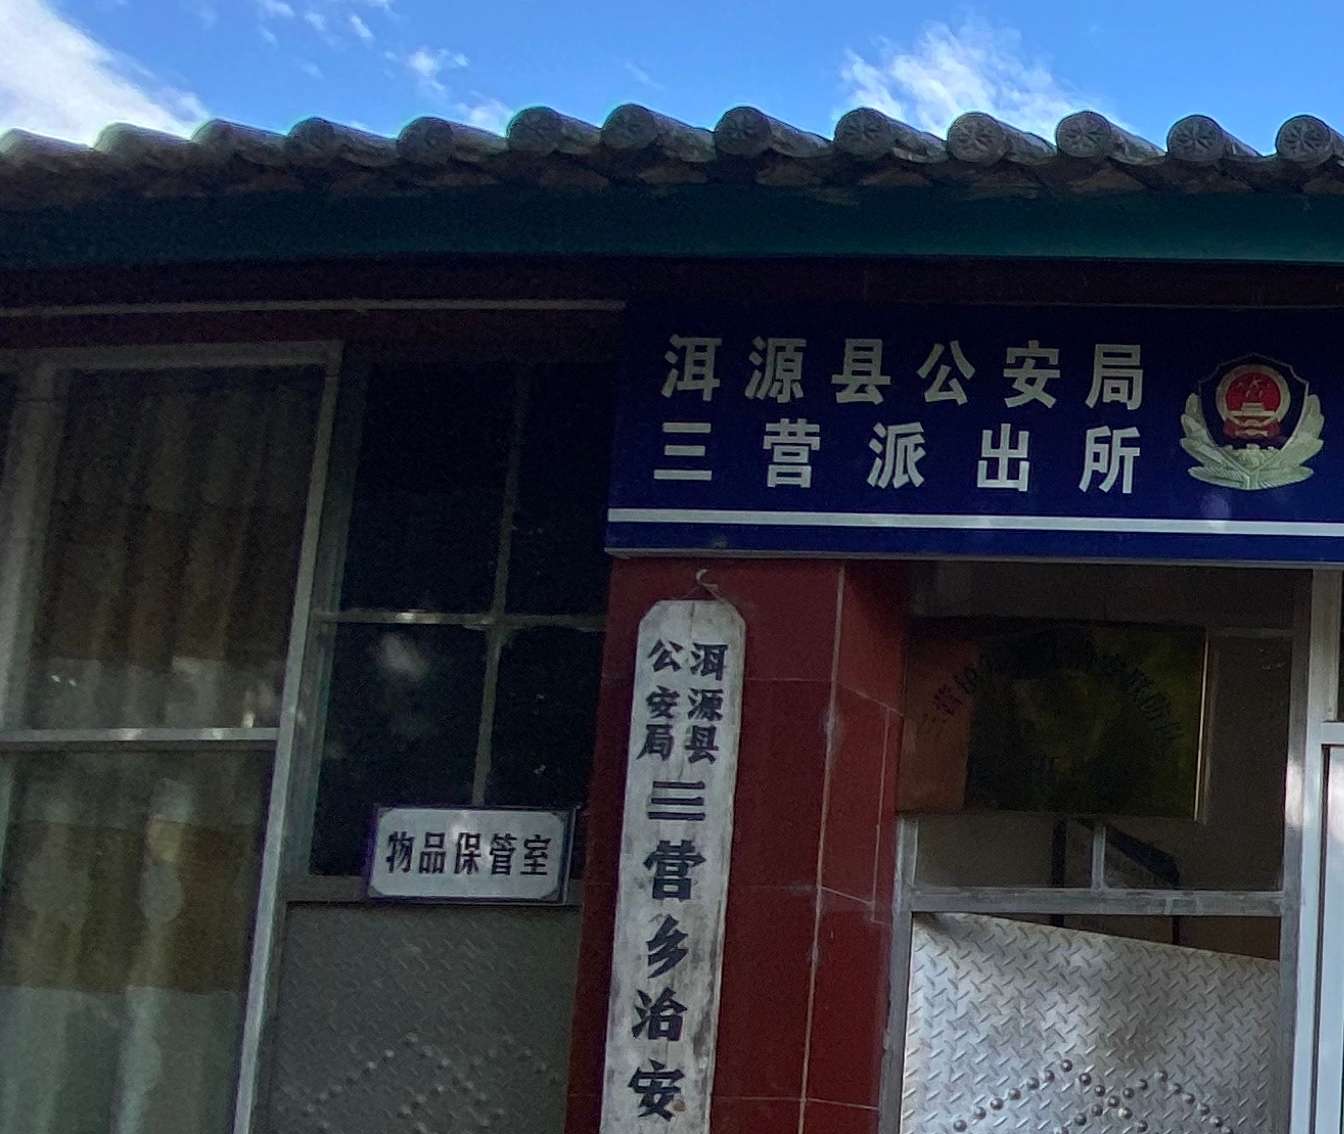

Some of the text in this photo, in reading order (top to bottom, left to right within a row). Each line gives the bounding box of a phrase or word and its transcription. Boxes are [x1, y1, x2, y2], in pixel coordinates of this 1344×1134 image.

[660, 333, 1144, 411] 洱源县公安局
[653, 417, 1141, 494] 三营派出所
[636, 638, 684, 762] 公安局
[686, 641, 729, 764] 洱源县
[385, 830, 553, 876] 物品保管室
